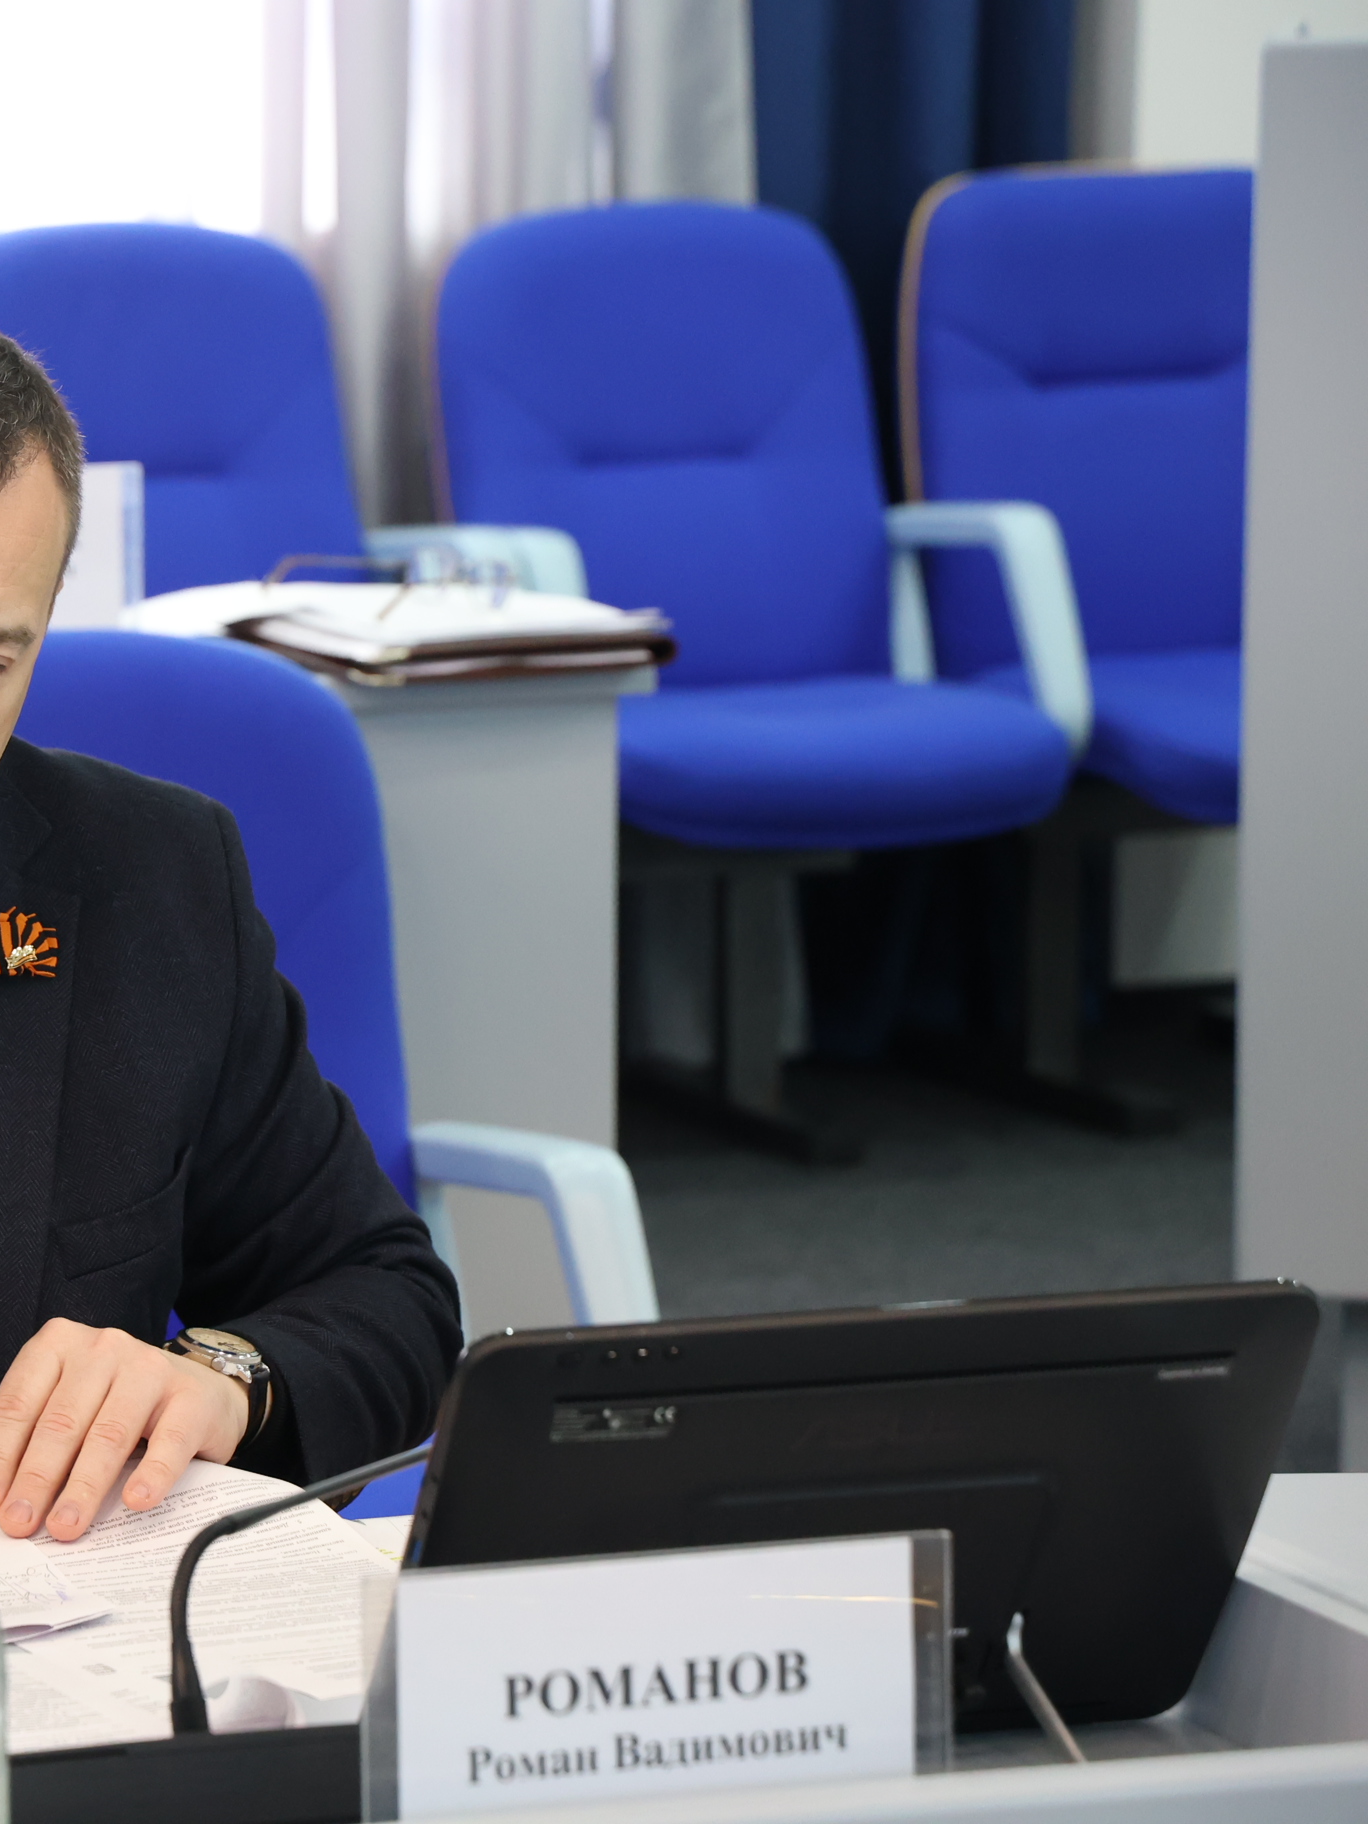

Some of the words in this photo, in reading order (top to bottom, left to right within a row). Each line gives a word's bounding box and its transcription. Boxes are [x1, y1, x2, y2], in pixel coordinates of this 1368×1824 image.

[503, 1649, 810, 1719] РОМАНОВ
[467, 1747, 599, 1785] Роман
[613, 1723, 848, 1772] Вадимович
